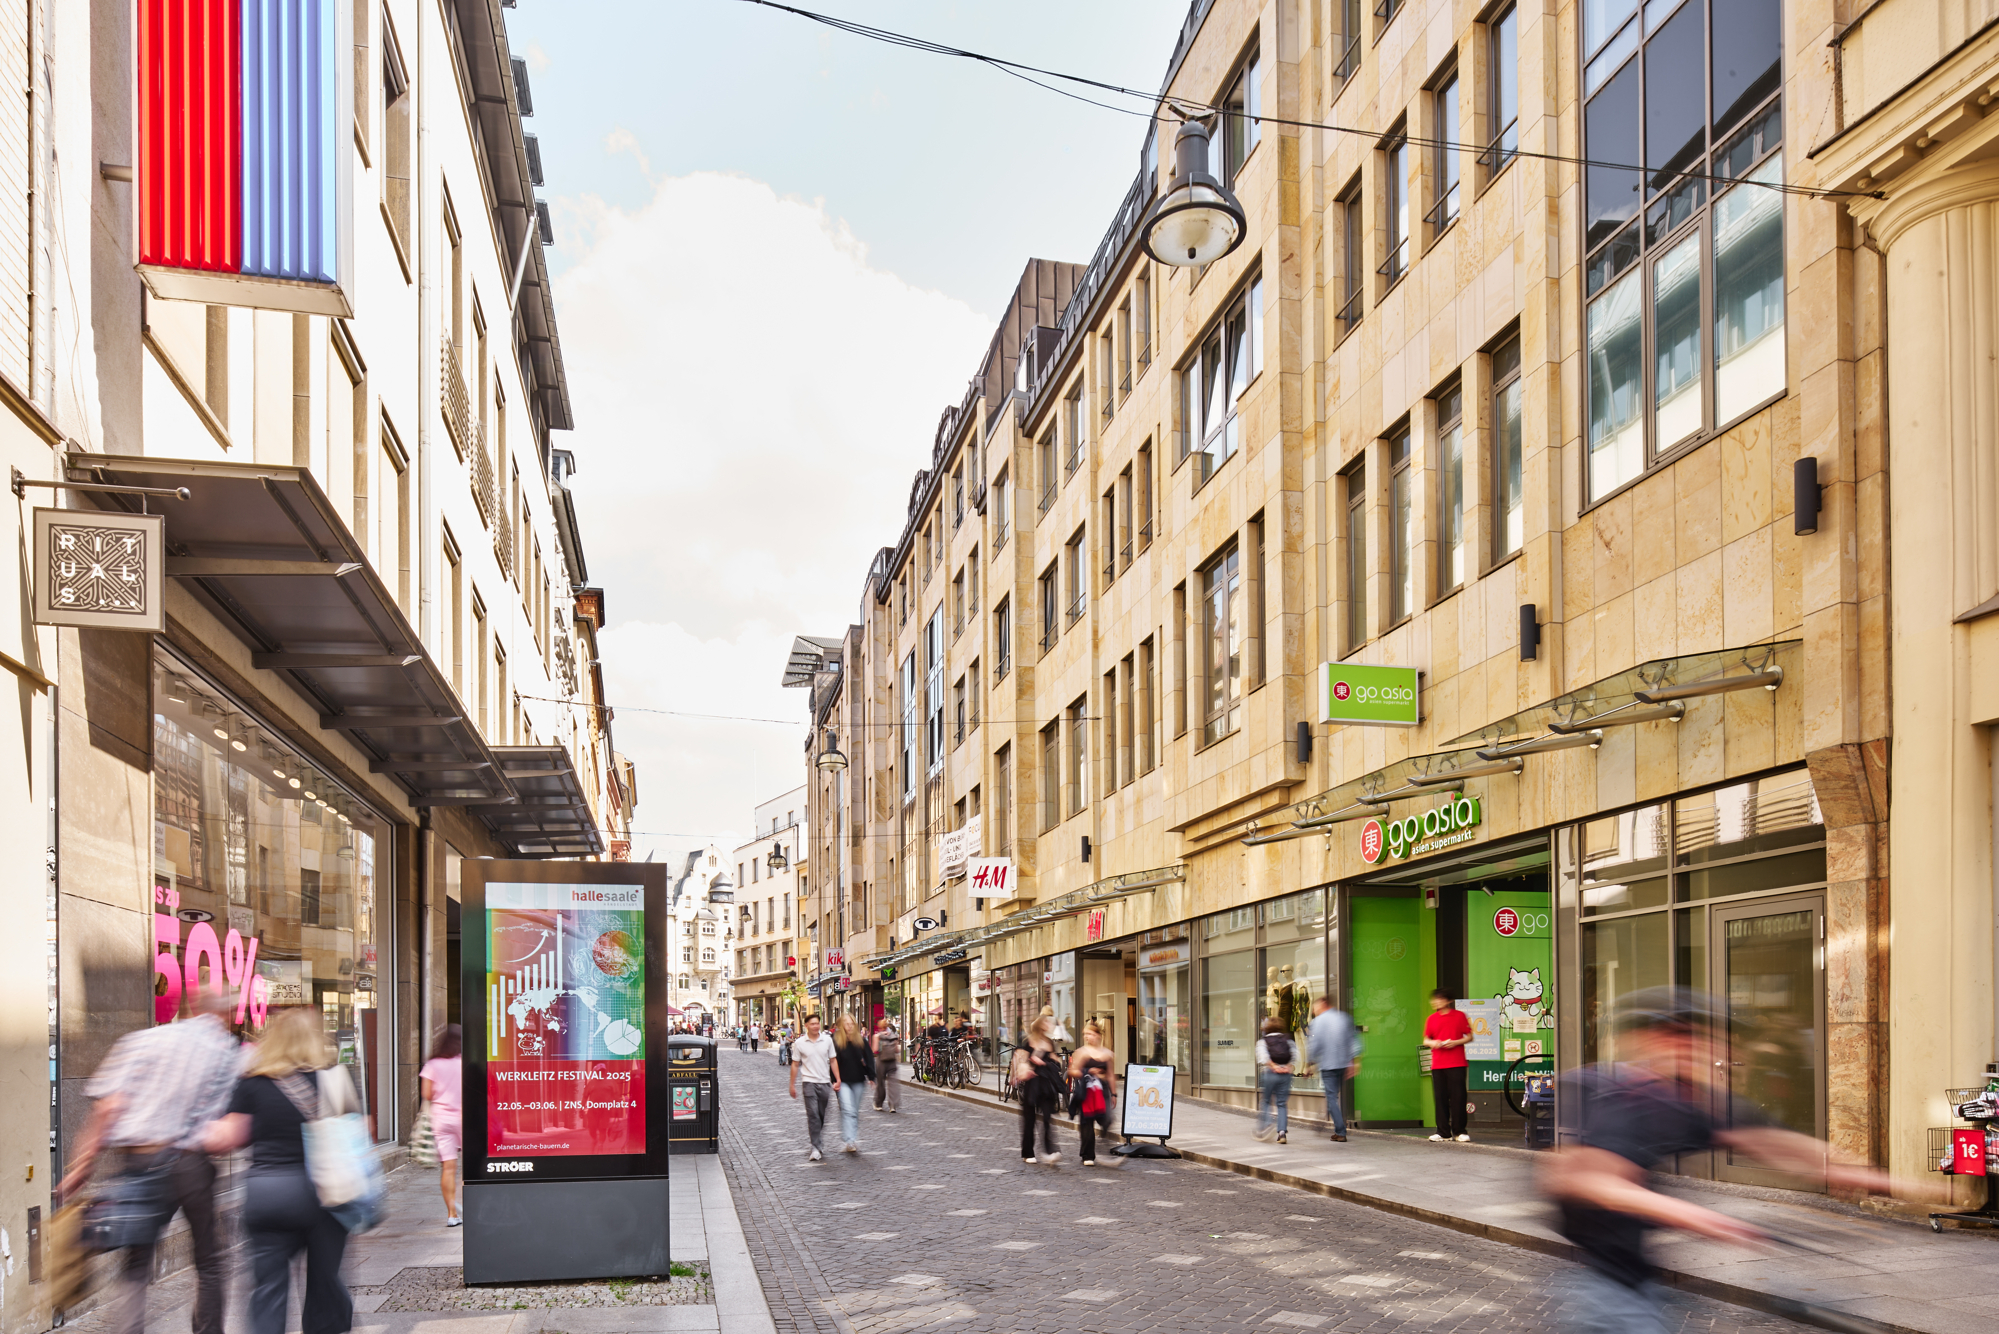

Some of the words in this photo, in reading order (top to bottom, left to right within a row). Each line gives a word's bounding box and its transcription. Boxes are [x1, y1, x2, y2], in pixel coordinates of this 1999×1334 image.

[1356, 686, 1378, 703] go
[1381, 685, 1413, 700] asia
[1389, 815, 1420, 859] go
[1424, 793, 1475, 836] asia
[1412, 843, 1430, 855] asien
[1430, 829, 1472, 850] supermarkt
[972, 865, 1008, 890] H&M
[155, 885, 164, 904] IS
[165, 886, 180, 909] ZU
[1523, 913, 1549, 935] go
[827, 950, 843, 965] kik
[154, 913, 268, 1029] 50%
[496, 1071, 555, 1081] WERKLEITZ
[558, 1070, 604, 1080] FESTIVAL
[606, 1072, 631, 1082] 2025
[564, 1101, 585, 1110] ZNS,
[586, 1100, 629, 1110] Domplatz
[630, 1100, 637, 1108] 4
[1134, 1086, 1164, 1109] 10%
[1126, 1122, 1168, 1130] 07.06.2025
[1962, 1143, 1979, 1159] 1€
[487, 1161, 534, 1173] STRÖER
